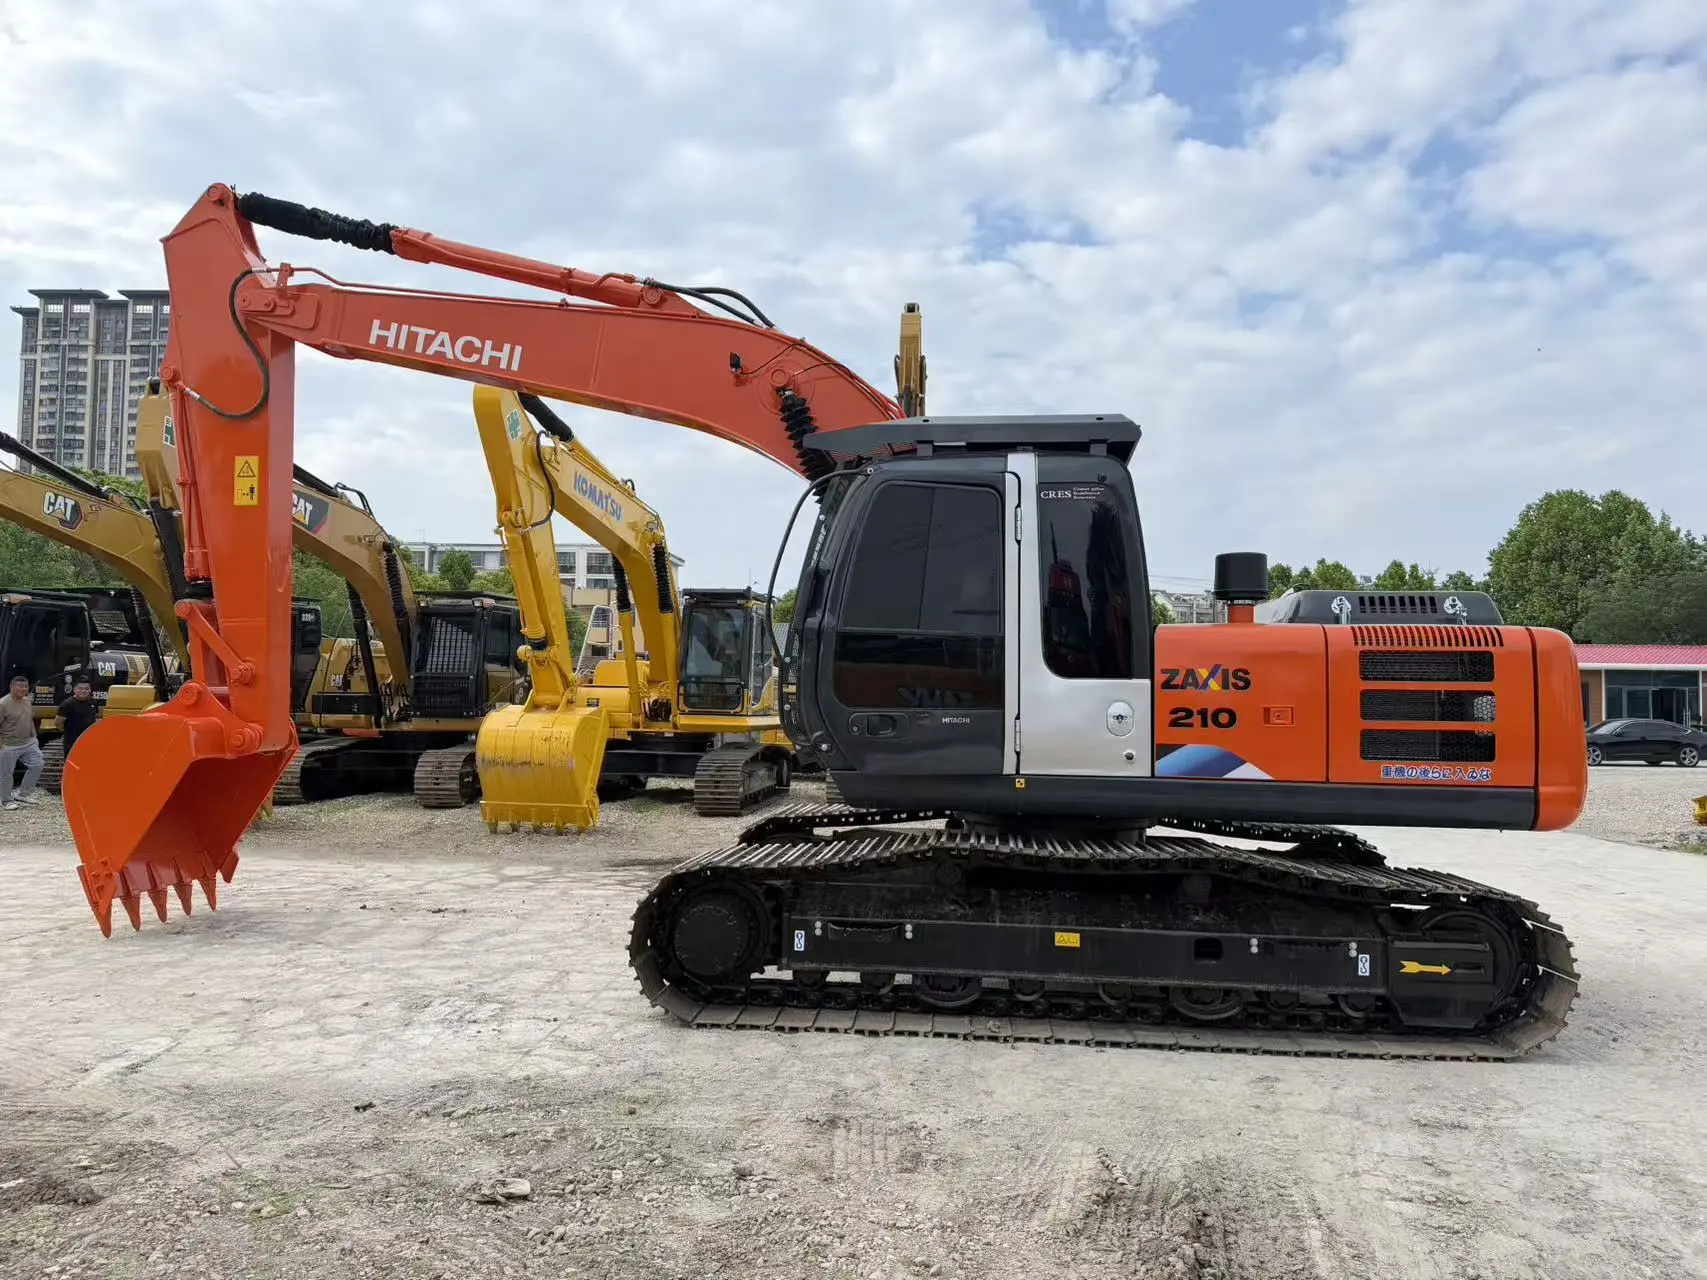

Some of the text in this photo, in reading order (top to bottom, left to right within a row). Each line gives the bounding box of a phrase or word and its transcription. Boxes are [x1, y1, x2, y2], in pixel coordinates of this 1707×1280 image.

[368, 319, 523, 372] HITACHI
[43, 490, 76, 521] CAT
[573, 470, 623, 521] KOMATSU
[1040, 490, 1072, 499] CRES
[97, 661, 116, 677] CAT
[1160, 664, 1252, 691] ZAXIS
[1168, 706, 1237, 729] 210
